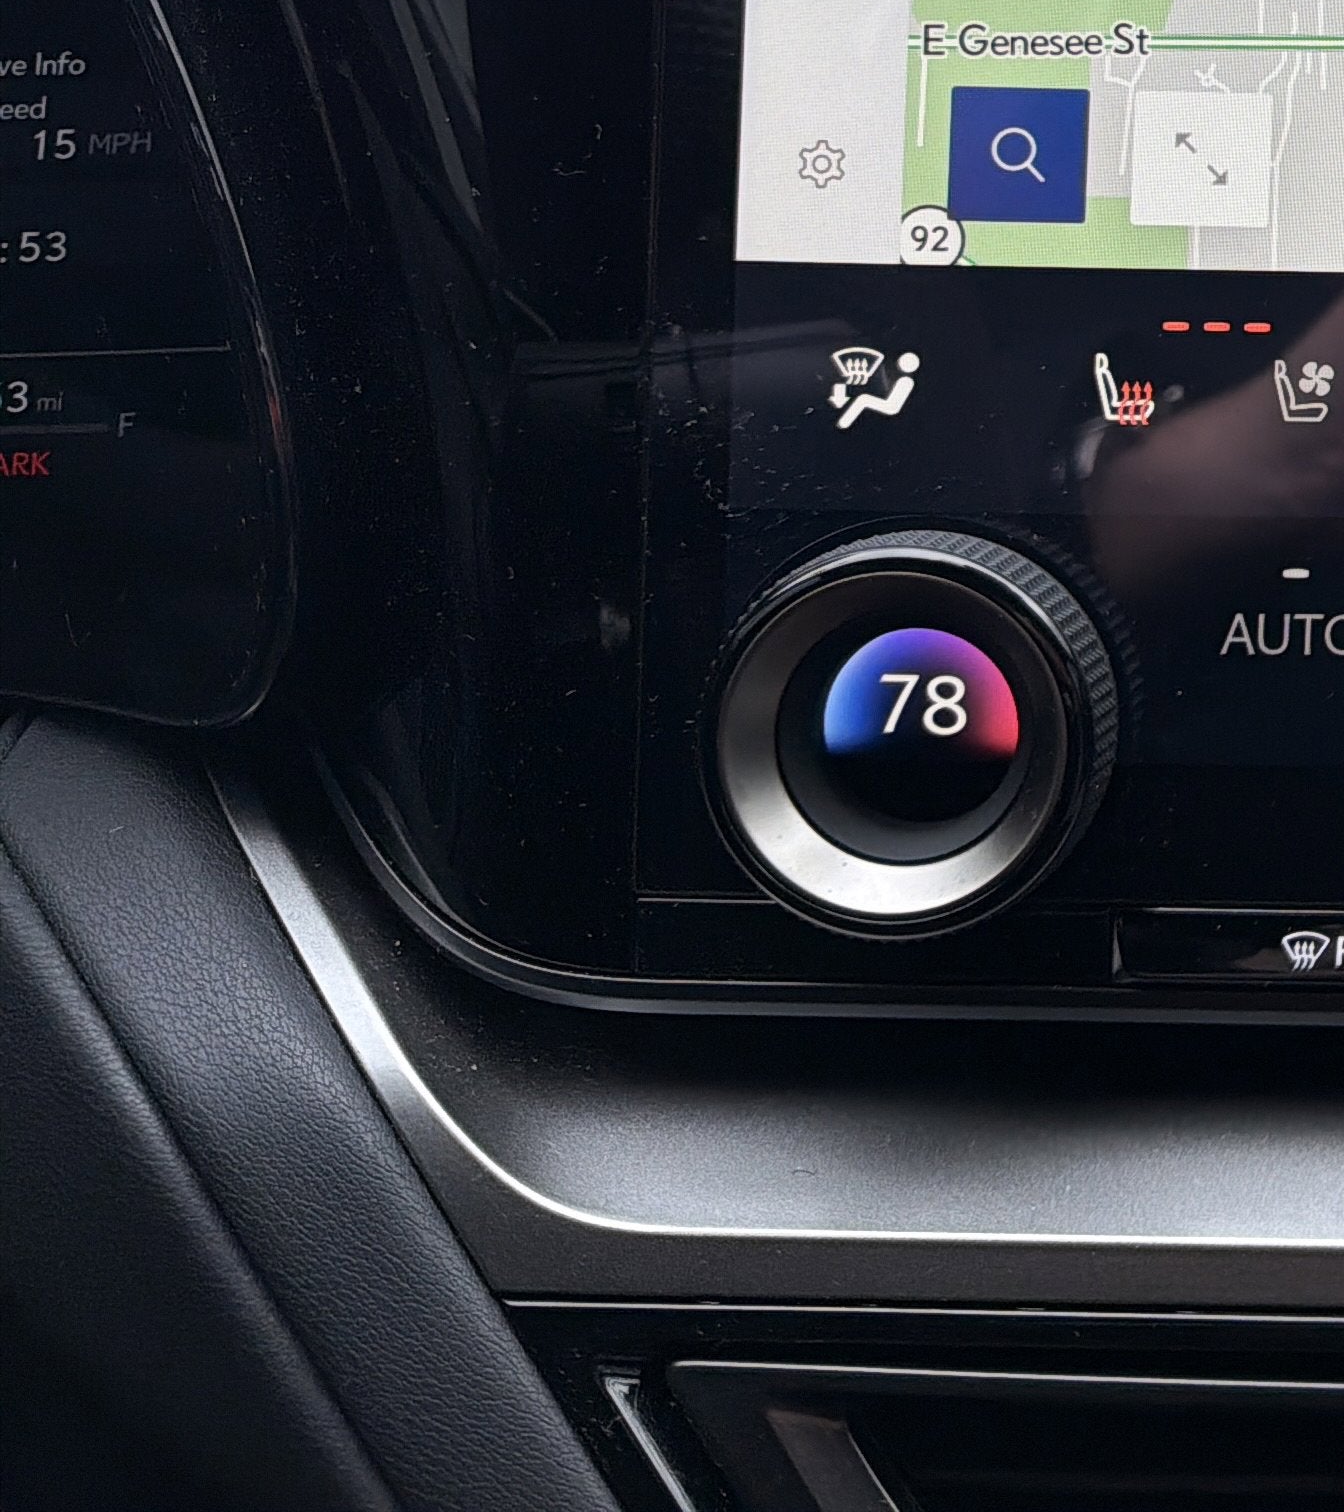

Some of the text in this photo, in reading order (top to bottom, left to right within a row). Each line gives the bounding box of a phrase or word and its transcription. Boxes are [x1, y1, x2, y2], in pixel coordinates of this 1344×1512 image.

[923, 24, 1150, 57] E Genesee St
[35, 50, 87, 76] Info
[33, 128, 152, 161] 15 MPH
[910, 226, 949, 253] 92
[0, 380, 64, 413] 3 mi
[117, 412, 137, 438] F
[878, 674, 968, 737] 78
